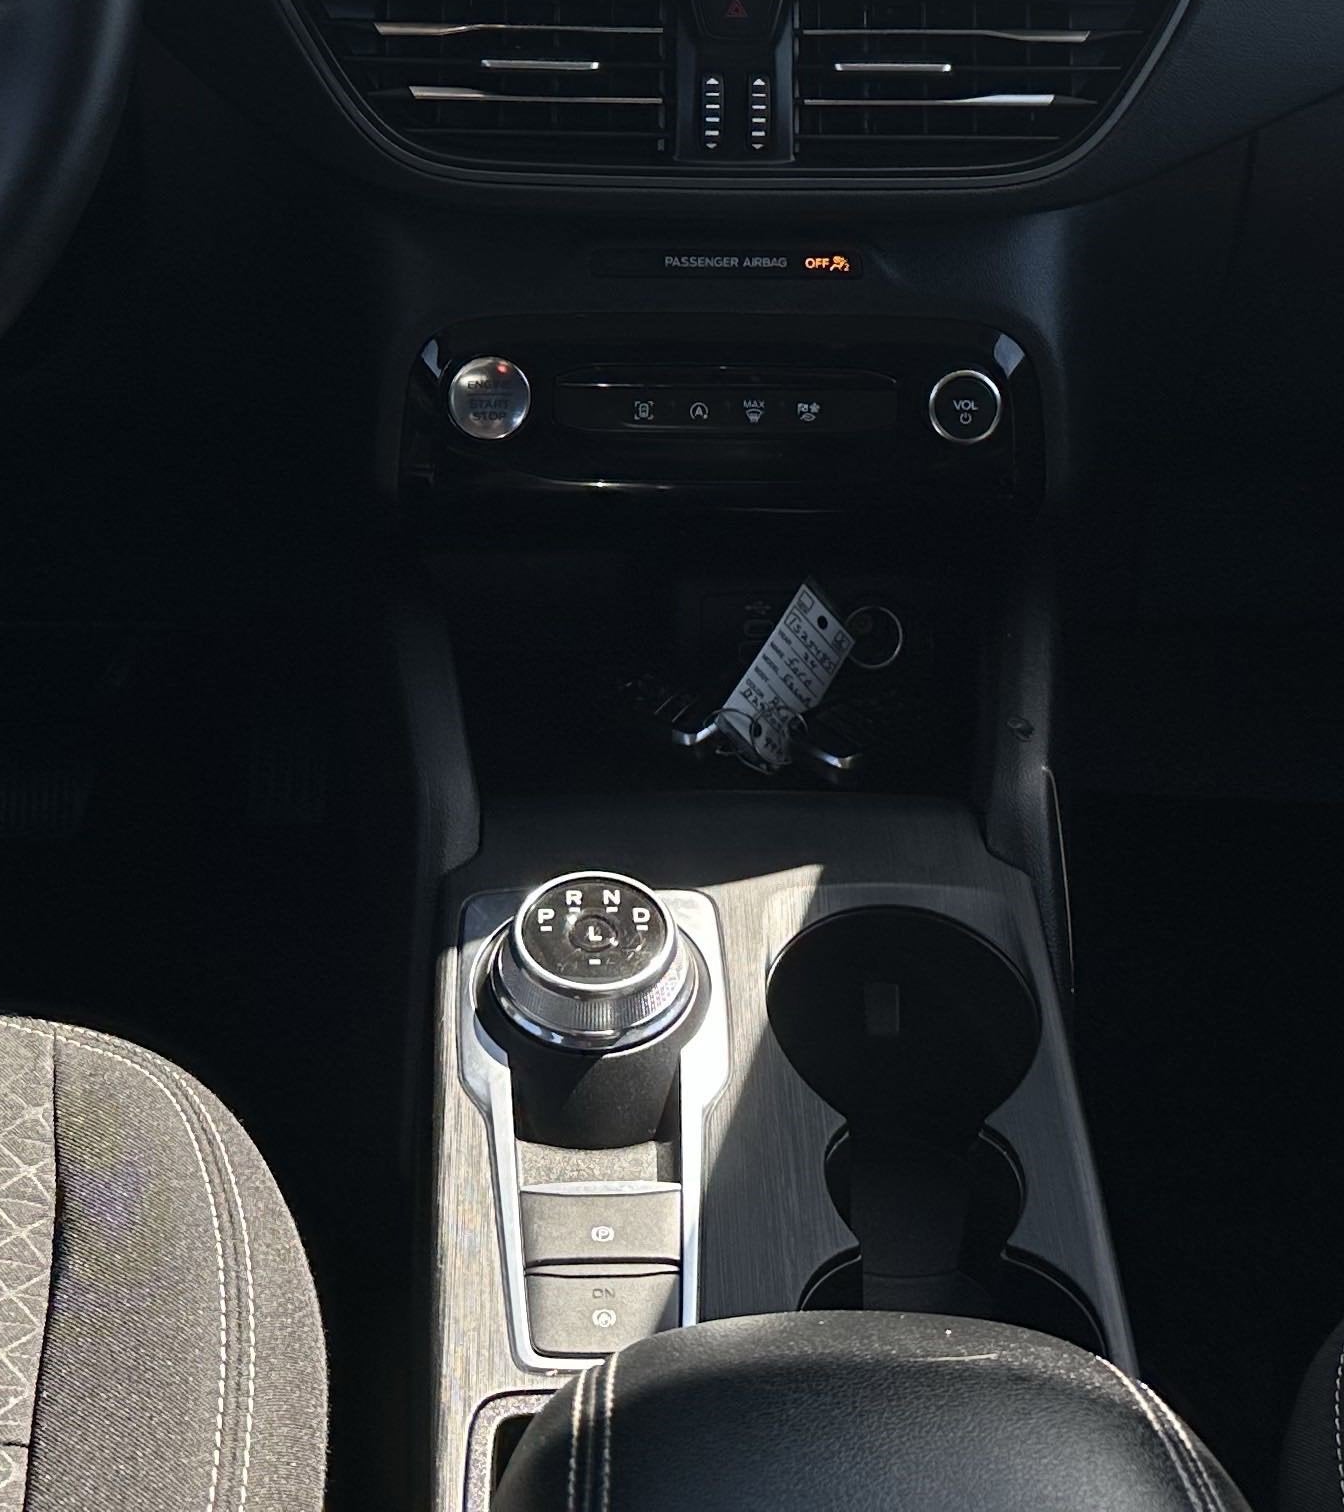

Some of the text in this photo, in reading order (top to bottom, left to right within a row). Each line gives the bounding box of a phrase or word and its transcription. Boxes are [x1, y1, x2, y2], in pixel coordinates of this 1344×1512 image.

[665, 256, 830, 269] PASSENGER AIRBAG OFF
[469, 399, 509, 409] START
[743, 400, 765, 409] MAX
[953, 400, 978, 412] VOL
[472, 411, 506, 421] STOP
[565, 889, 583, 905] R
[603, 889, 621, 905] N
[537, 908, 555, 924] P
[632, 907, 650, 923] D
[588, 926, 603, 941] L
